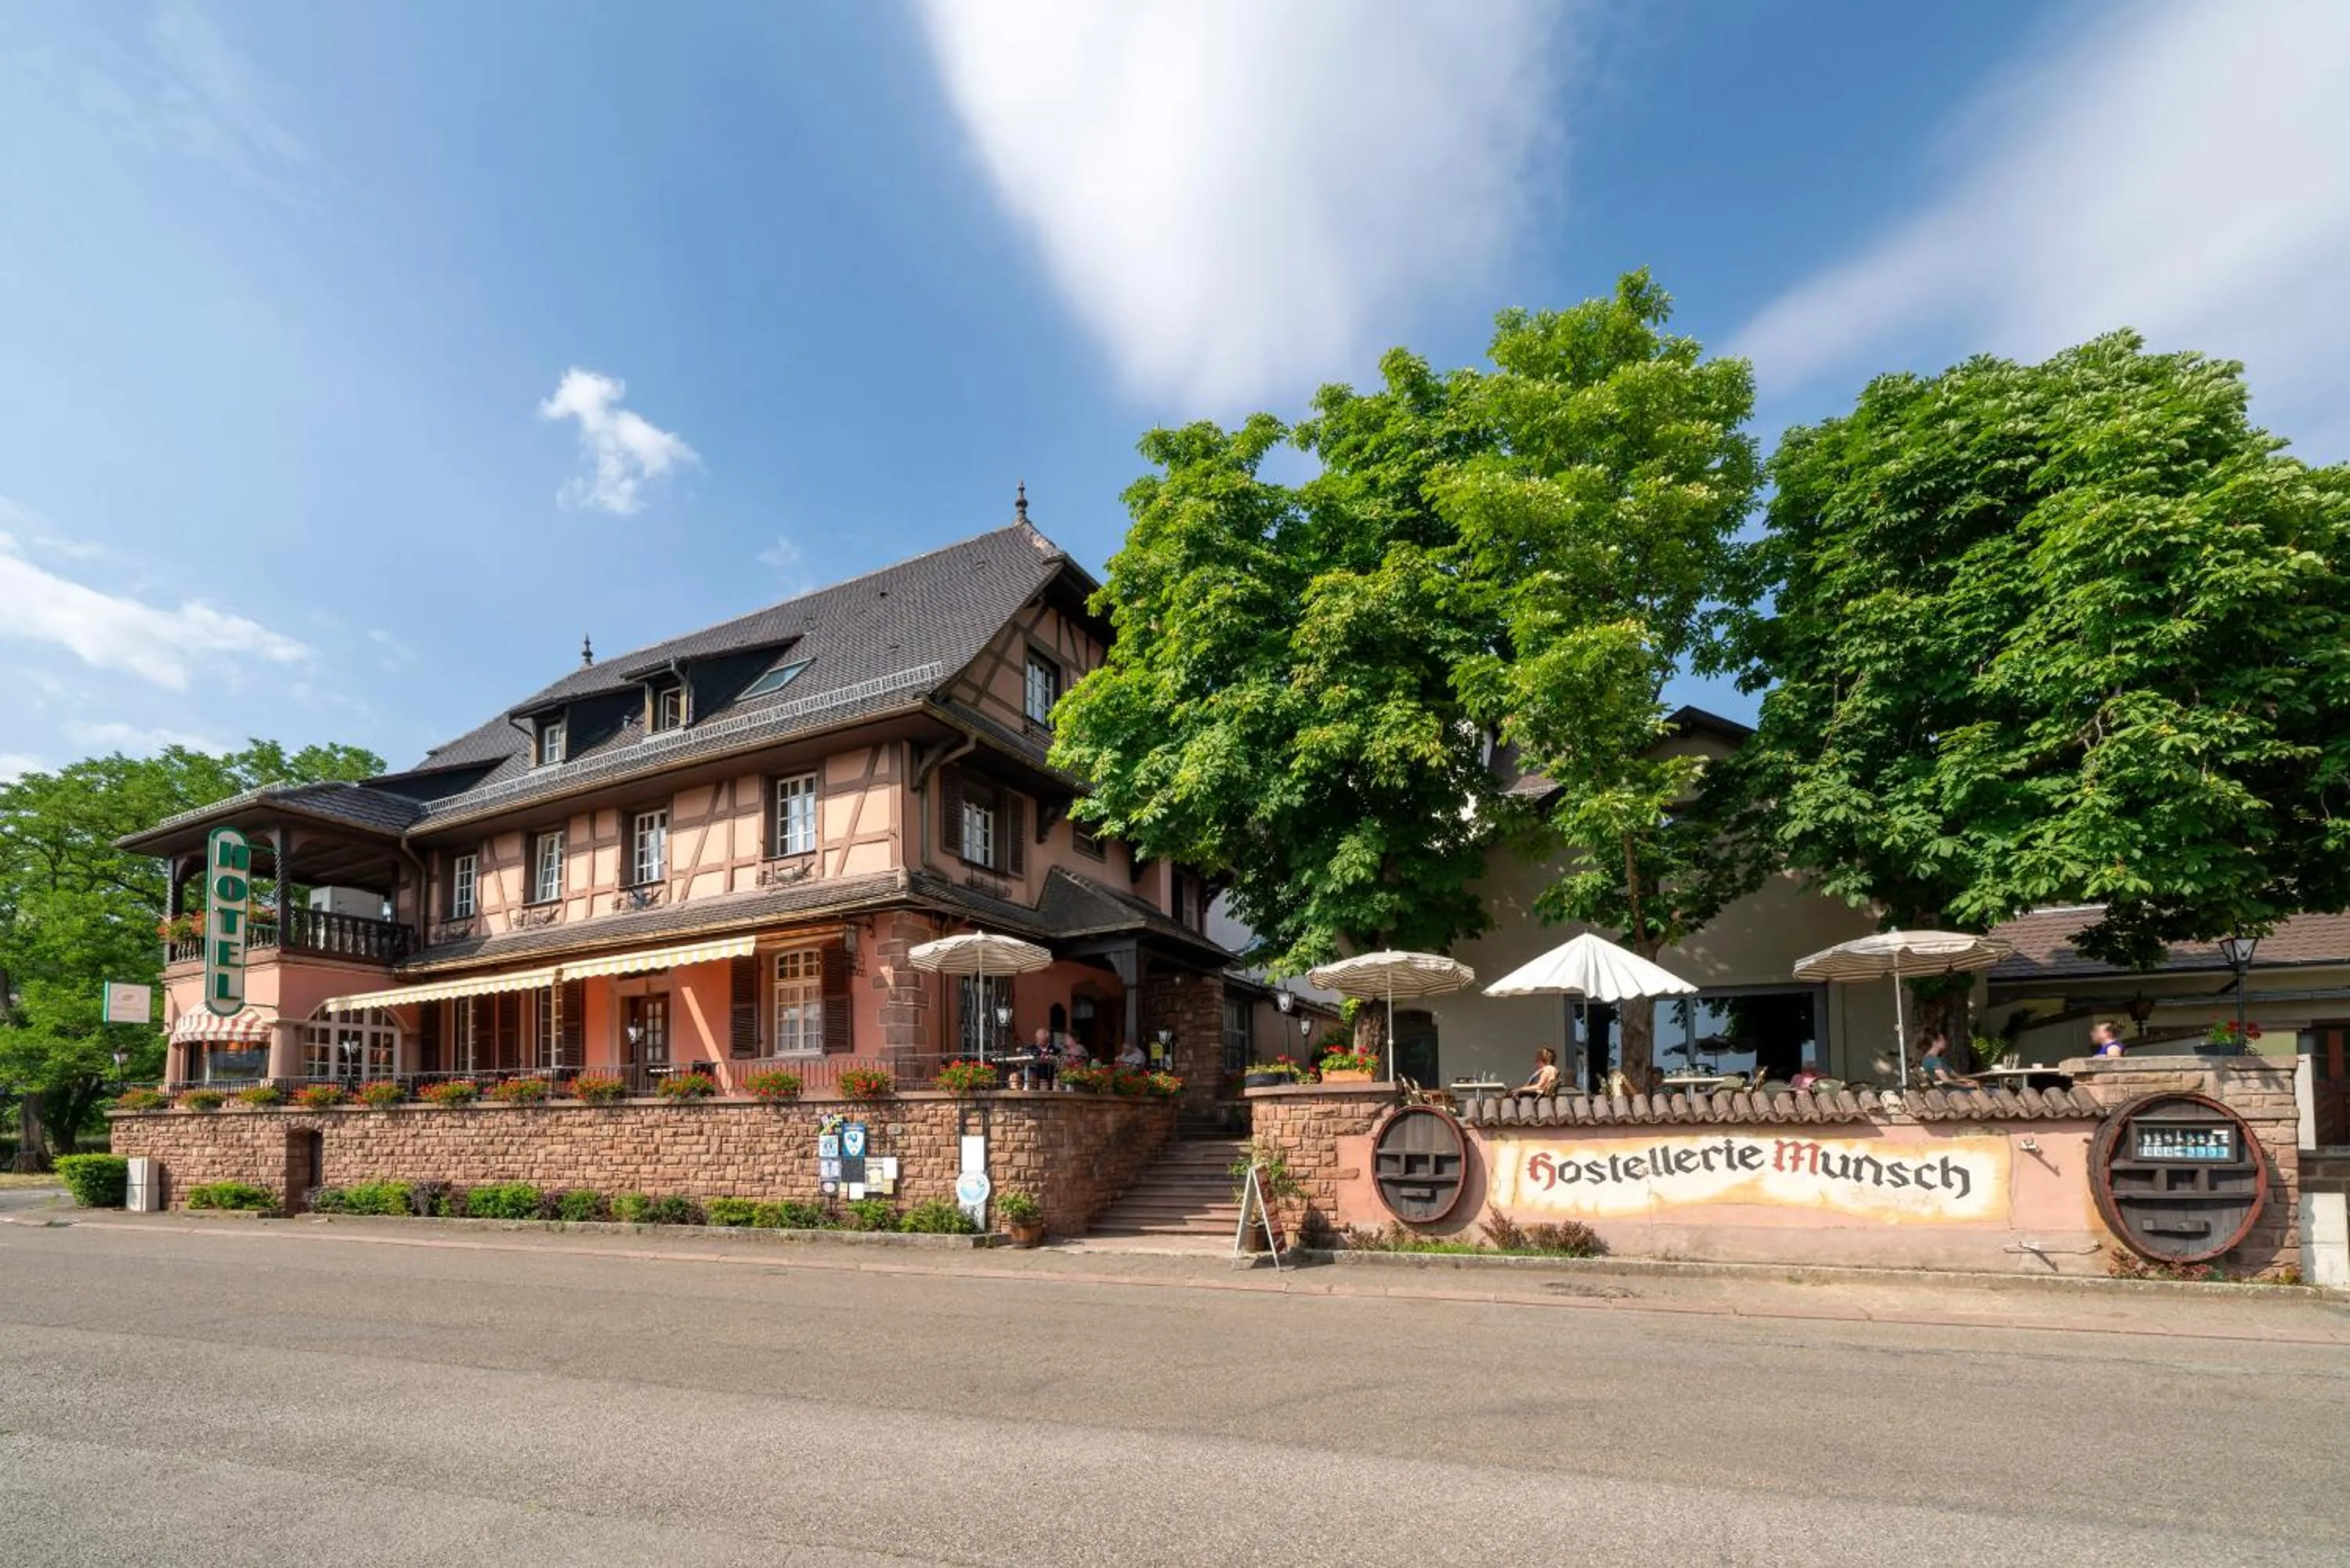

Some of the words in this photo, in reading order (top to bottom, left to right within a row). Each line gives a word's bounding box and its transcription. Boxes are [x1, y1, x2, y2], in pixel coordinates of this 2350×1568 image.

[215, 841, 248, 1000] HOTEL
[1528, 1138, 1763, 1190] Hostellerie
[1772, 1139, 1971, 1199] Munsch
